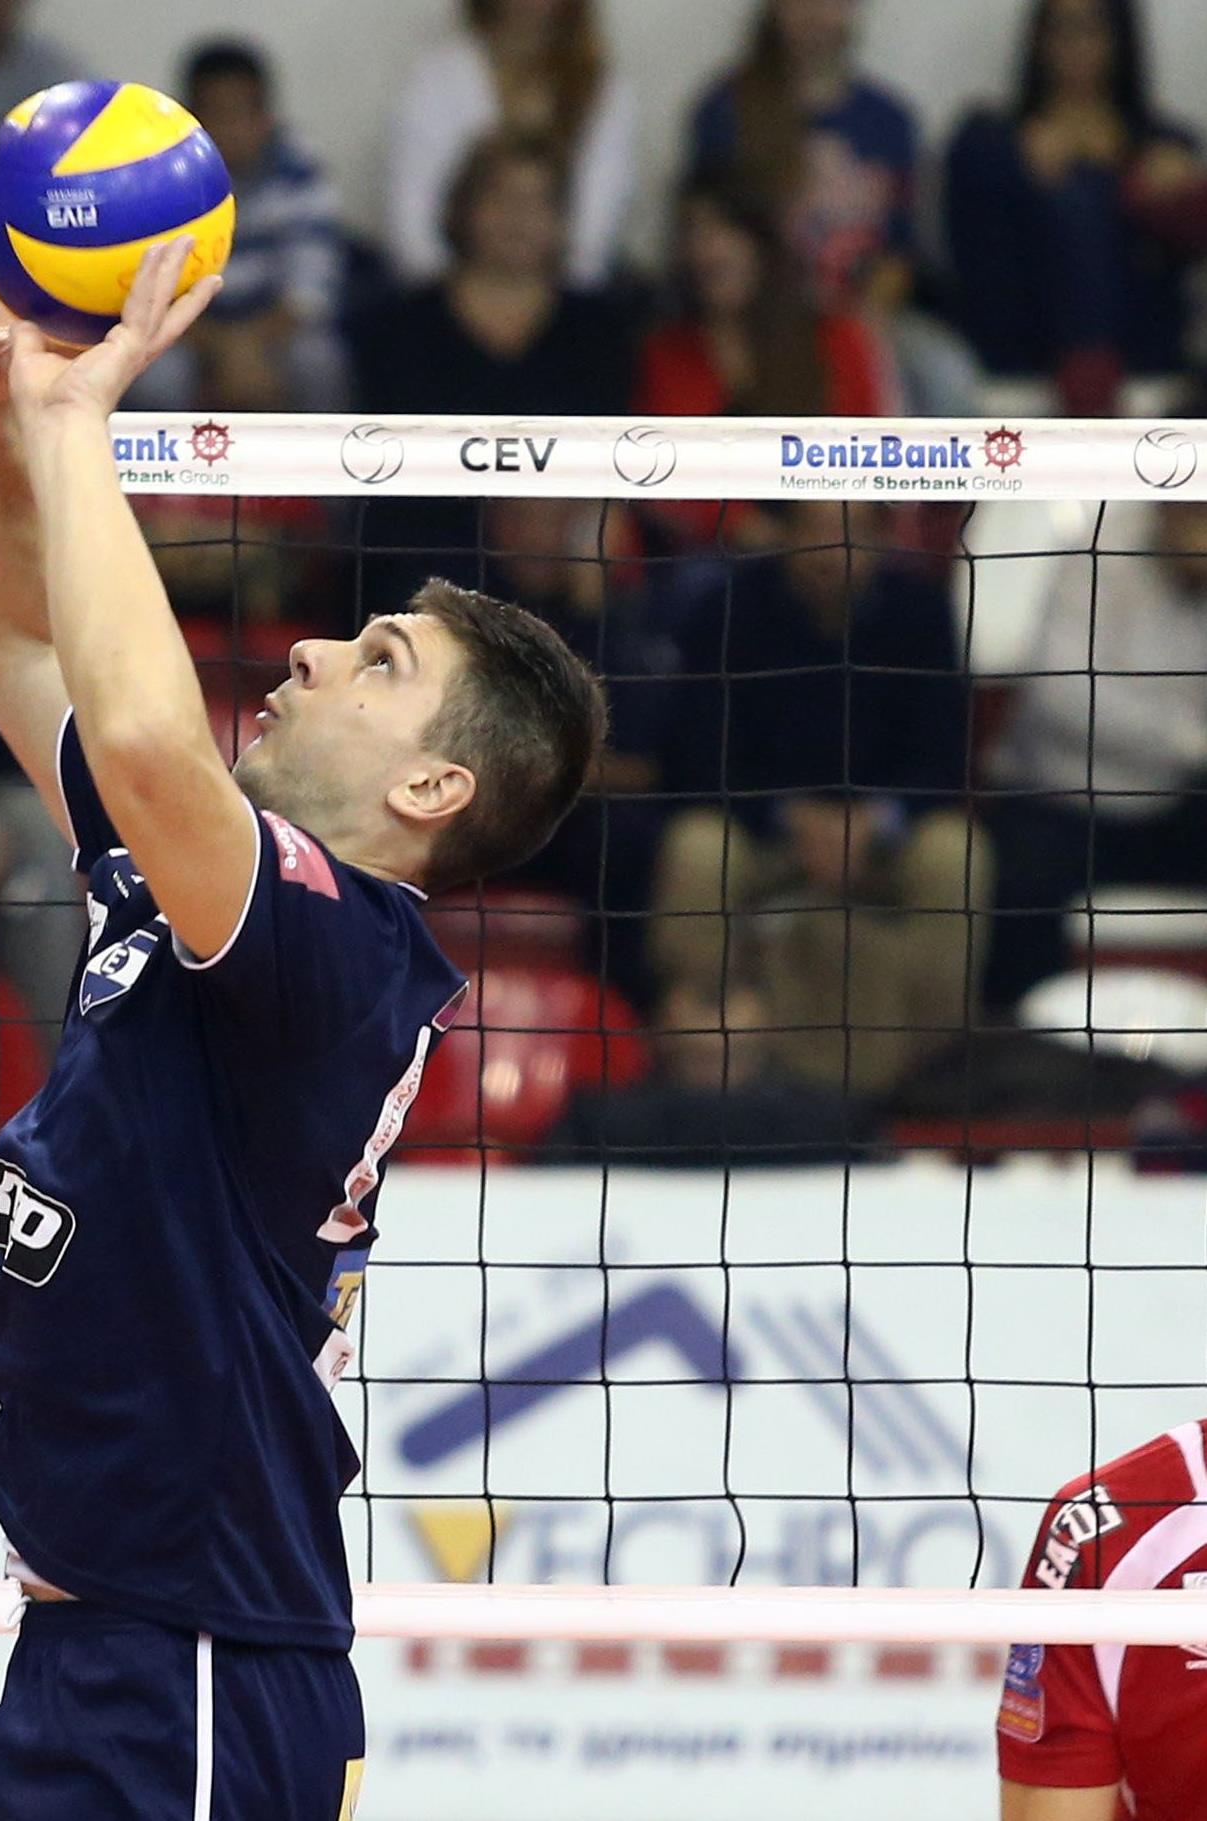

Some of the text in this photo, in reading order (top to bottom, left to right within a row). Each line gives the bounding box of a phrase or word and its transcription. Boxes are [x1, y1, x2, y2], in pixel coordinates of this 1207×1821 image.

[459, 437, 558, 473] CEV
[781, 434, 972, 469] DenizBank
[179, 469, 230, 485] Group
[780, 475, 1023, 492] Member of Sberbank Group
